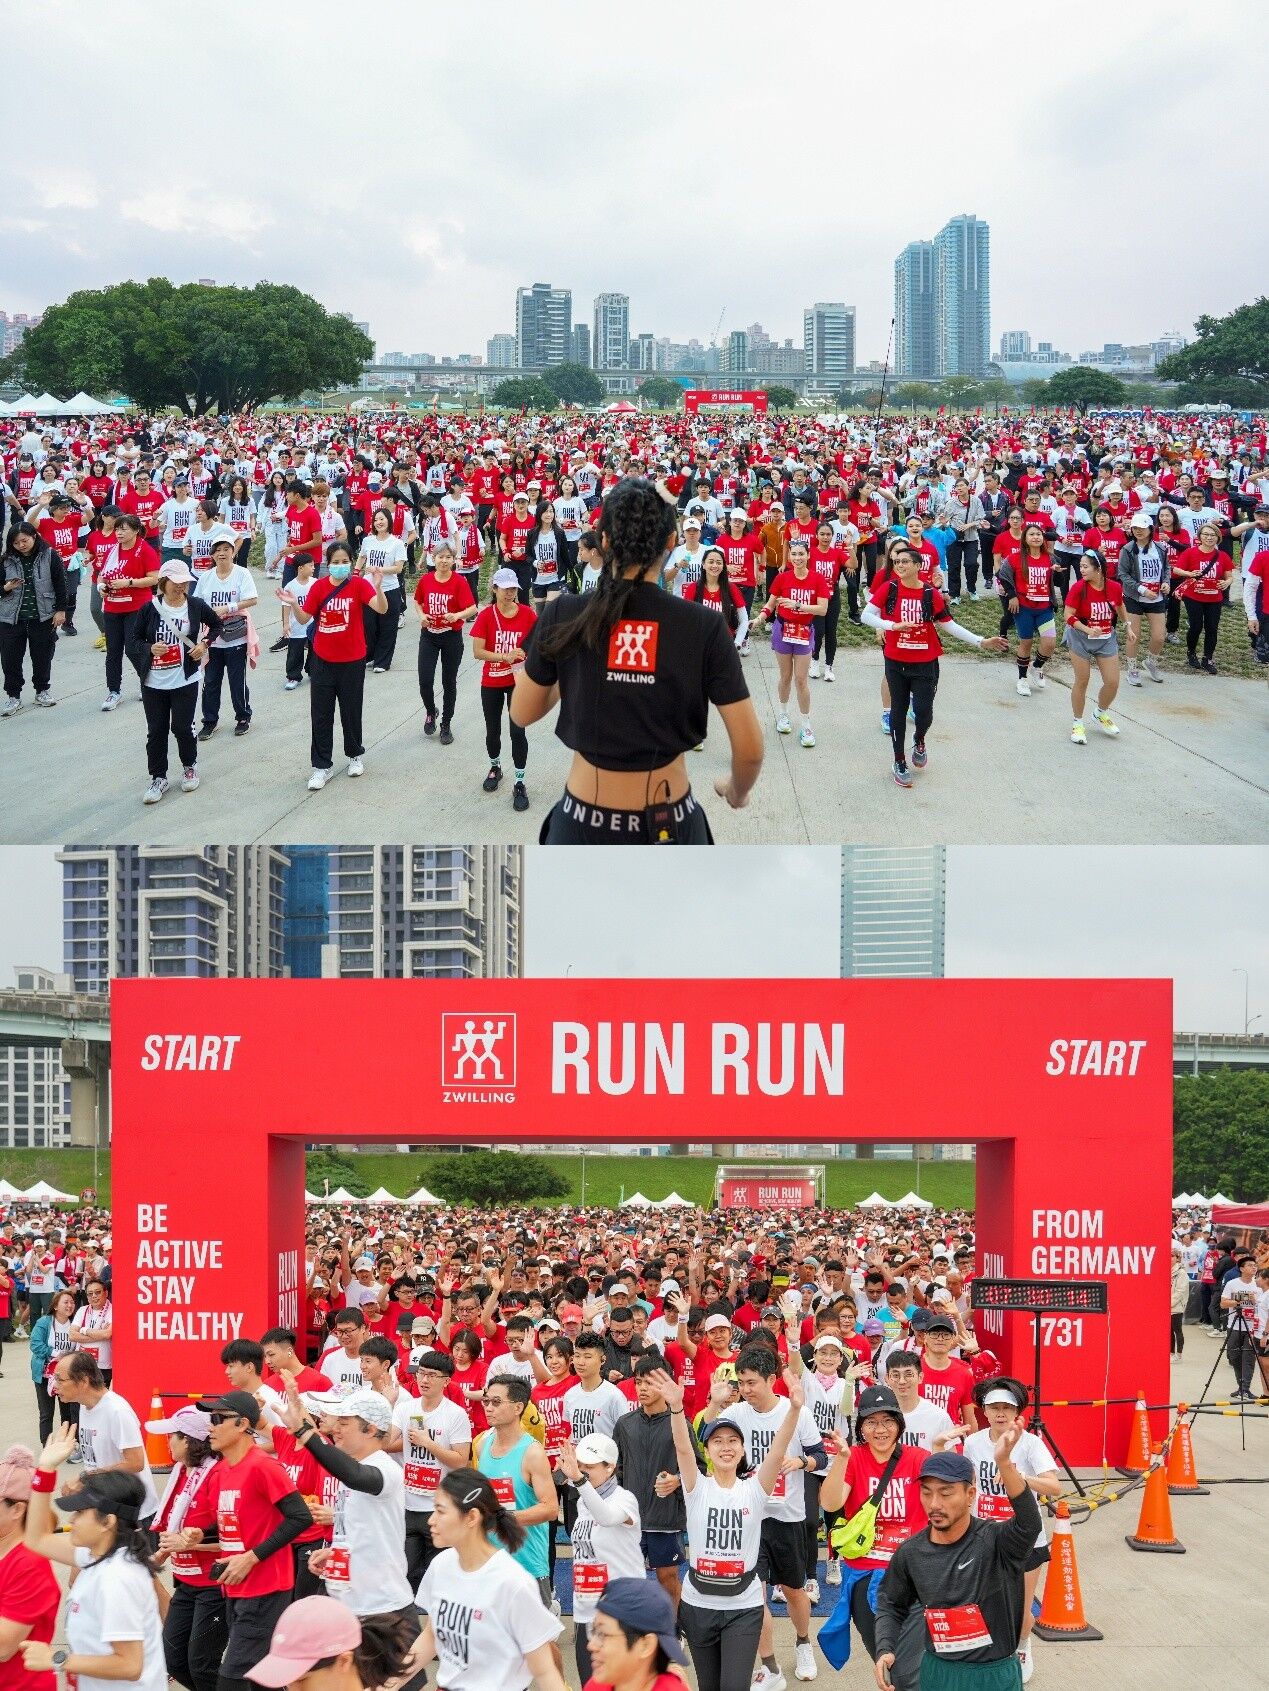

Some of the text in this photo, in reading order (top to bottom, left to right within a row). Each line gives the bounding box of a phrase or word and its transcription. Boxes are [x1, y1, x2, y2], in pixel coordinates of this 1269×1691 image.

[370, 550, 386, 559] RUN
[729, 548, 745, 557] RUN
[816, 561, 833, 570] RUN
[1028, 567, 1048, 577] RUN
[1142, 559, 1160, 569] RUN
[1142, 568, 1160, 578] RUN
[211, 592, 231, 602] RUN
[429, 593, 449, 604] RUN
[791, 589, 810, 600] RUN
[327, 598, 350, 610] RUN
[430, 604, 448, 614] RUN
[496, 630, 518, 643] RUN
[606, 672, 655, 684] ZWILLING
[563, 797, 640, 832] UNDER
[141, 1035, 240, 1071] START
[552, 1022, 845, 1096] RUN RUN
[1046, 1039, 1147, 1077] START
[442, 1092, 516, 1104] ZWILLING
[759, 1187, 801, 1198] RUN RUN
[138, 1204, 168, 1232] BE
[1033, 1210, 1103, 1238] FROM
[137, 1240, 222, 1269] ACTIVE
[1032, 1246, 1156, 1274] GERMANY
[278, 1250, 298, 1293] RUN
[984, 1253, 1003, 1278] RUN
[138, 1276, 195, 1304] STAY
[278, 1290, 298, 1329] RUN
[138, 1312, 243, 1340] HEALTHY
[984, 1310, 1003, 1336] RUN
[1030, 1318, 1082, 1346] 1731
[925, 1384, 950, 1400] RUN
[539, 1397, 559, 1412] RUN
[814, 1401, 836, 1418] RUN
[573, 1409, 595, 1424] RUN
[814, 1414, 835, 1431] RUN
[980, 1461, 998, 1478] RU
[878, 1498, 905, 1517] UN
[707, 1507, 742, 1528] RUN
[706, 1528, 742, 1550] RUN
[437, 1599, 473, 1636] RUN
